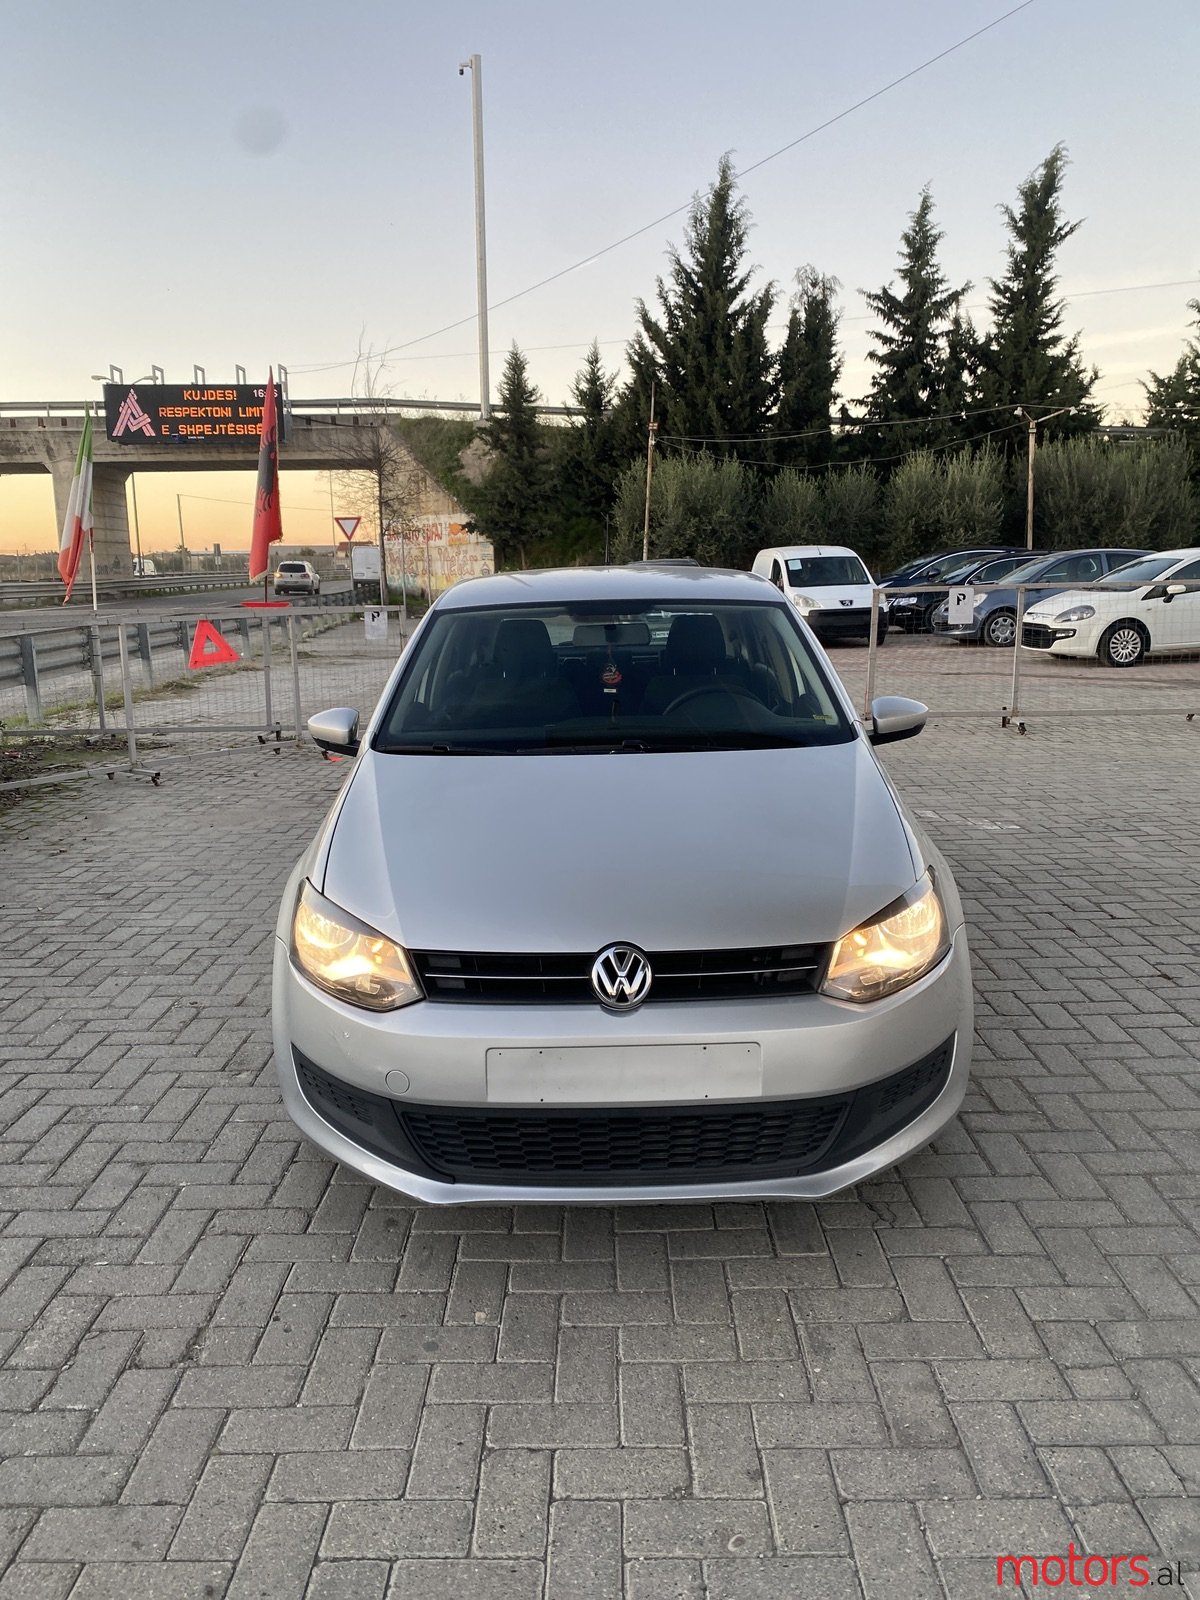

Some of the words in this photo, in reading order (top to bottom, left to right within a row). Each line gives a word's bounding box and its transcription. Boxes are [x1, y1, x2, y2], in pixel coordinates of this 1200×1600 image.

[183, 390, 237, 401] KUJDES!
[158, 407, 232, 418] RESPEKTONI
[161, 424, 171, 435] E
